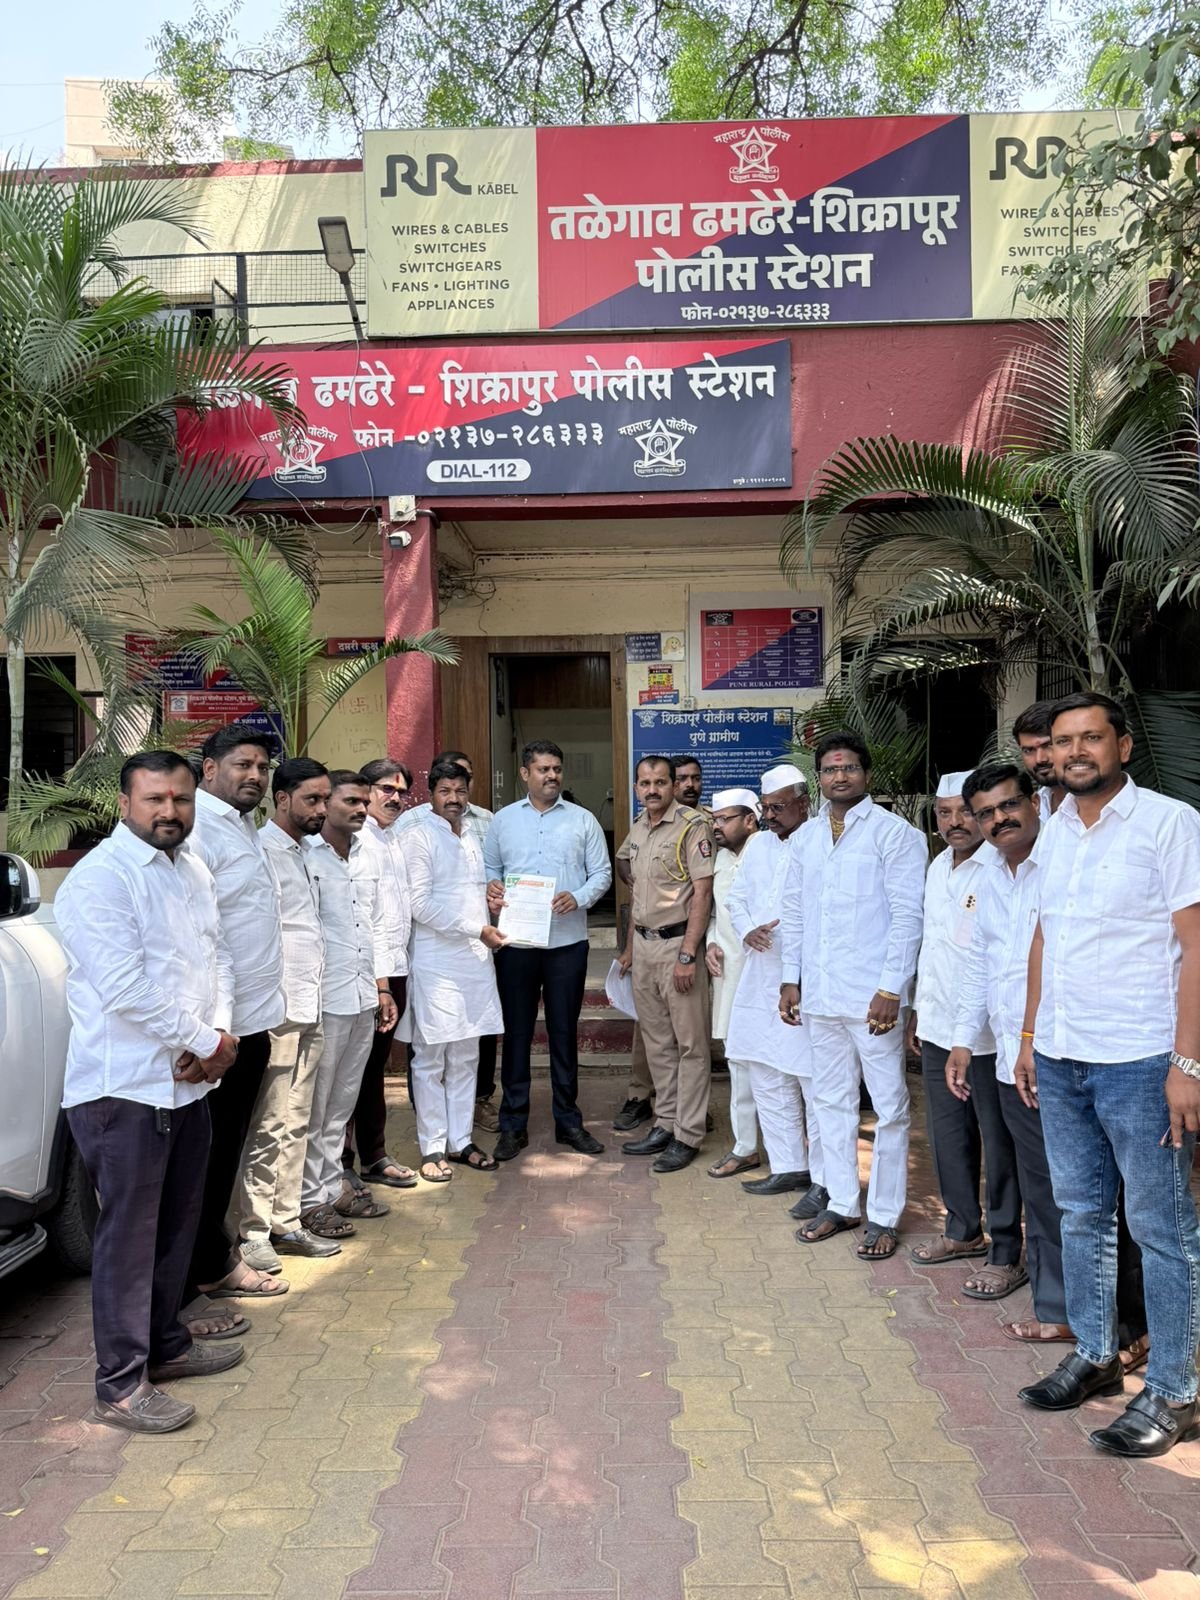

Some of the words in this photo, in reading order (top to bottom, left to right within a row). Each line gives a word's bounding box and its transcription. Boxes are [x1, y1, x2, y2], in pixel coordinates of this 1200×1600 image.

[713, 128, 747, 143] महाराष्ट्र
[760, 125, 791, 142] पोलीस
[381, 153, 472, 197] RR
[548, 193, 683, 240] तळेगाव
[690, 186, 960, 246] ढमढेरे-शिक्रापूर
[1000, 208, 1047, 219] WIRE
[1051, 207, 1060, 218] &
[391, 224, 437, 236] WIRES
[441, 223, 450, 235] &
[454, 222, 509, 234] CABLES
[414, 242, 487, 254] SWITCHES
[399, 260, 503, 274] SWITCHGEARS
[635, 245, 758, 294] पोलीस
[765, 243, 874, 291] स्टेशन
[392, 281, 429, 293] FANS
[444, 279, 510, 292] LIGHTING
[407, 298, 495, 311] APPLIANCES
[311, 360, 395, 407] ढमढेरे
[439, 359, 559, 417] शिक्रापुर
[569, 355, 674, 402] पोलीस
[685, 352, 777, 402] स्टेशन
[307, 424, 338, 442] पोलीस
[353, 420, 394, 448] फोन
[617, 419, 652, 436] महाराष्ट्र
[665, 416, 698, 435] पोलीस
[440, 463, 517, 479] DIAL-112
[661, 712, 700, 727] शिक्रापूर
[703, 709, 734, 724] पोलीस
[737, 708, 768, 723] स्टेशन
[689, 730, 706, 746] पुणे
[708, 730, 740, 743] ग्रामीण
